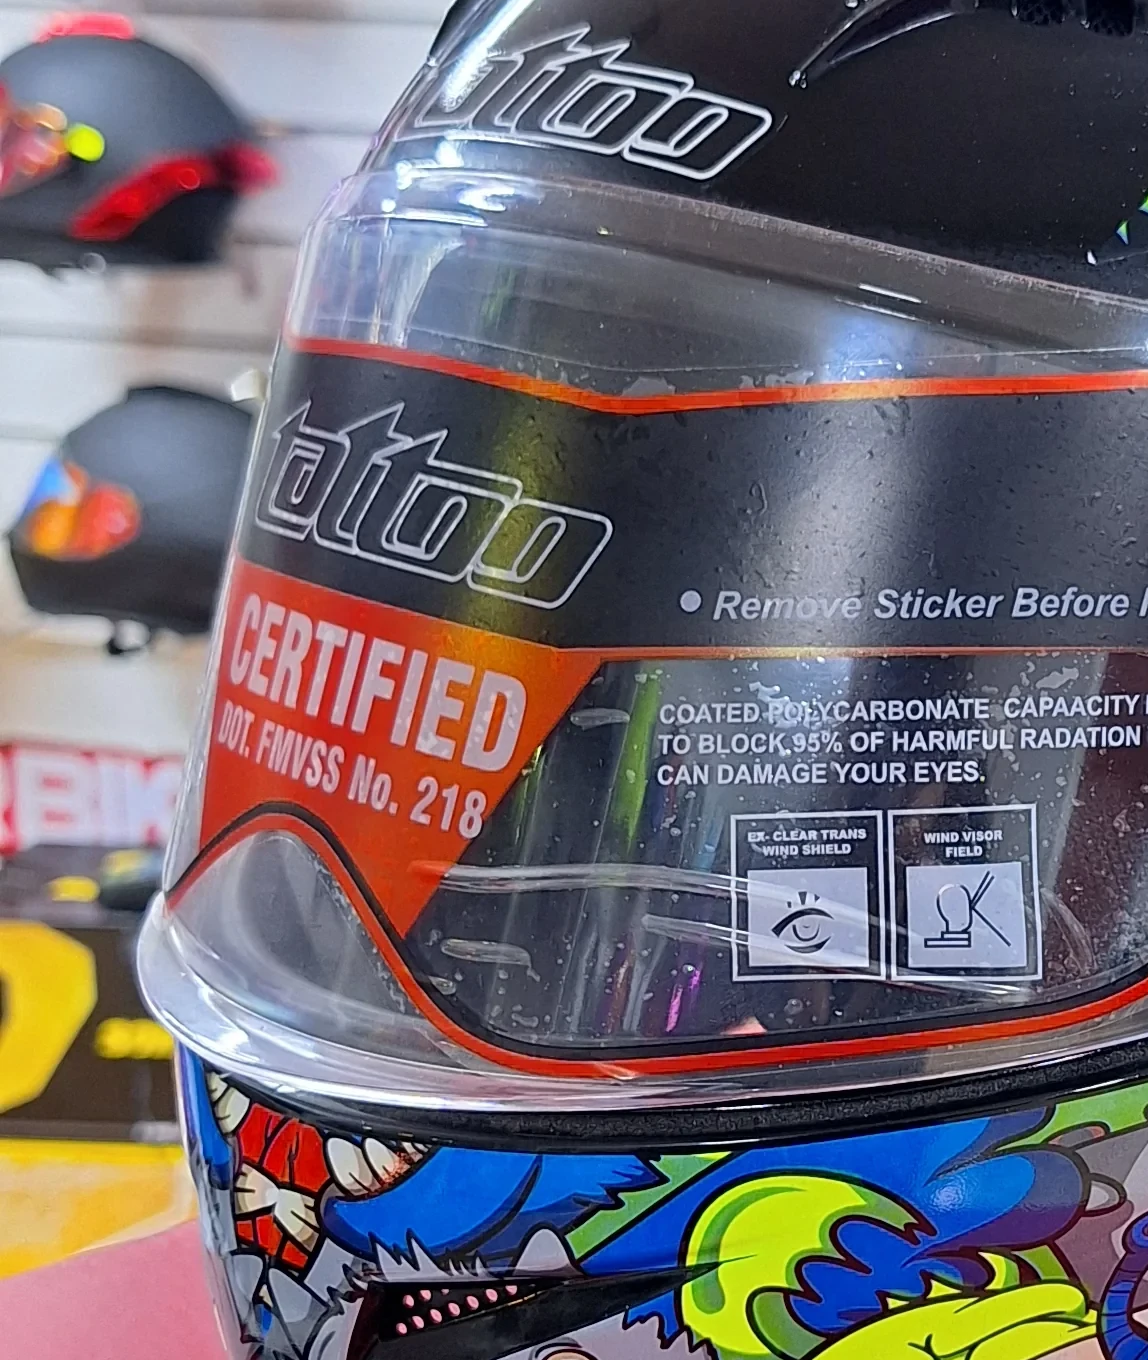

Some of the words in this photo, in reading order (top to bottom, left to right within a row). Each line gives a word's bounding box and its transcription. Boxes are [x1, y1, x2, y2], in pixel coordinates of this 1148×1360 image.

[712, 590, 862, 621] Remove
[874, 588, 1004, 620] Sticker
[1011, 587, 1130, 619] Before
[229, 592, 528, 773] CERTIFIED
[659, 703, 760, 726] COATED
[767, 699, 989, 726] POLYCARBONATE
[1003, 694, 1141, 719] CAPAACITY
[658, 734, 692, 756] TO
[698, 733, 786, 755] BLOCK
[792, 731, 843, 754] 95%
[850, 731, 885, 753] OF
[892, 728, 1013, 753] HARMFUL
[1020, 725, 1142, 749] RADATION
[218, 699, 256, 759] DOT.
[255, 718, 346, 795] FMVSS
[347, 753, 400, 816] No.
[409, 775, 488, 840] 218
[657, 764, 709, 787] CAN
[717, 762, 828, 786] DAMAGE
[834, 761, 906, 784] YOUR
[914, 761, 986, 783] EYES.
[773, 830, 817, 842] CLEAR
[820, 828, 868, 841] TRANS
[924, 831, 959, 844] WIND
[963, 830, 1004, 843] VISOR
[762, 844, 799, 857] WIND
[802, 843, 852, 856] SHIELD
[945, 846, 983, 858] FIELD
